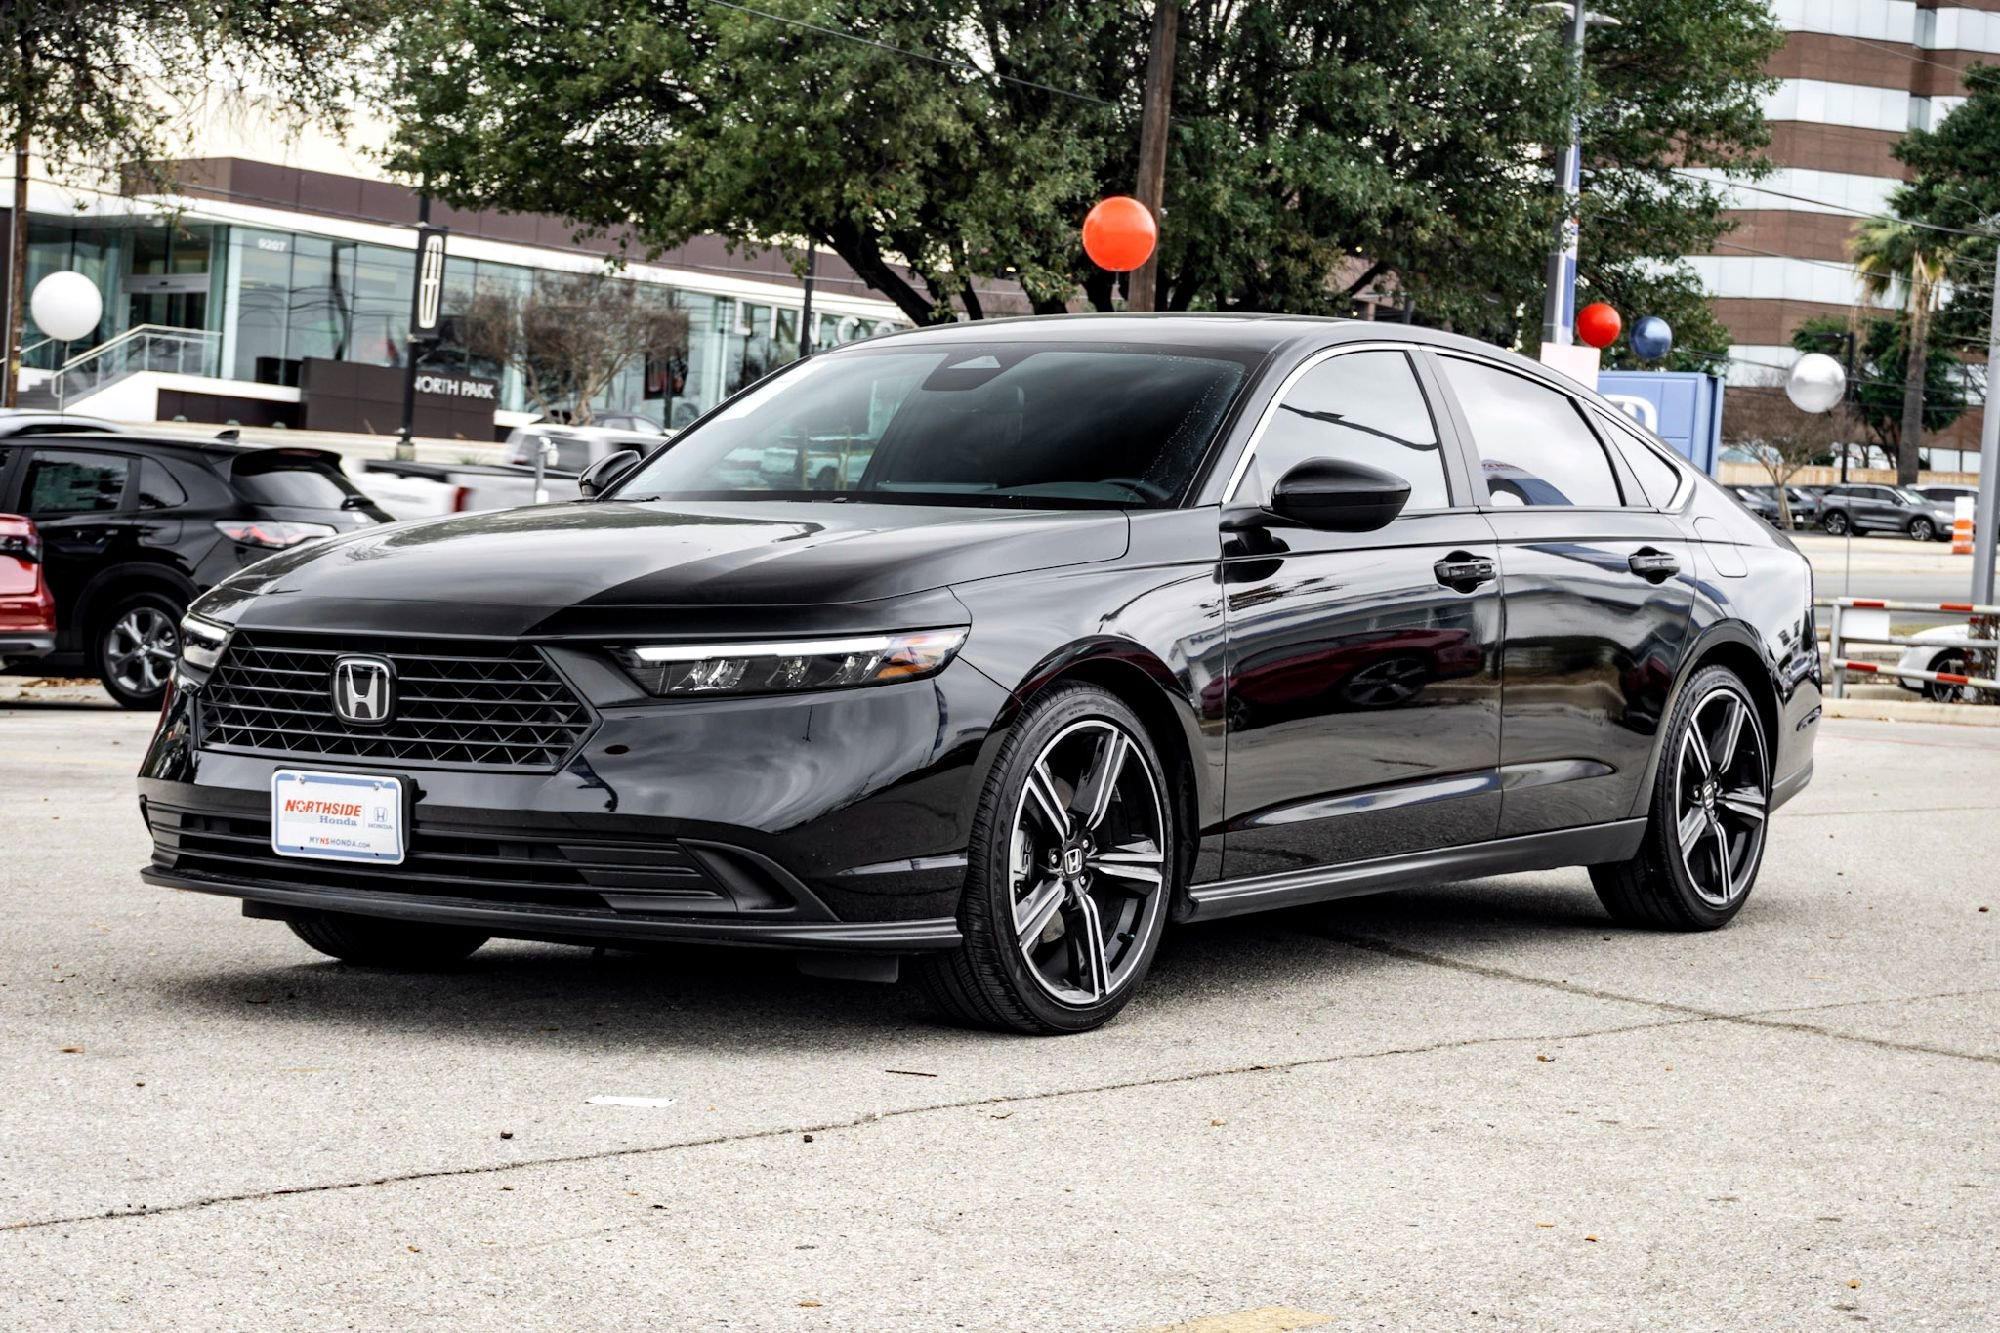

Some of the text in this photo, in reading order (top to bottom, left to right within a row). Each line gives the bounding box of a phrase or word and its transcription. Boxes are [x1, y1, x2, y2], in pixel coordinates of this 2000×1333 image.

[461, 380, 494, 399] PARK
[285, 799, 362, 817] NORTHSIDE
[319, 815, 357, 826] Honda
